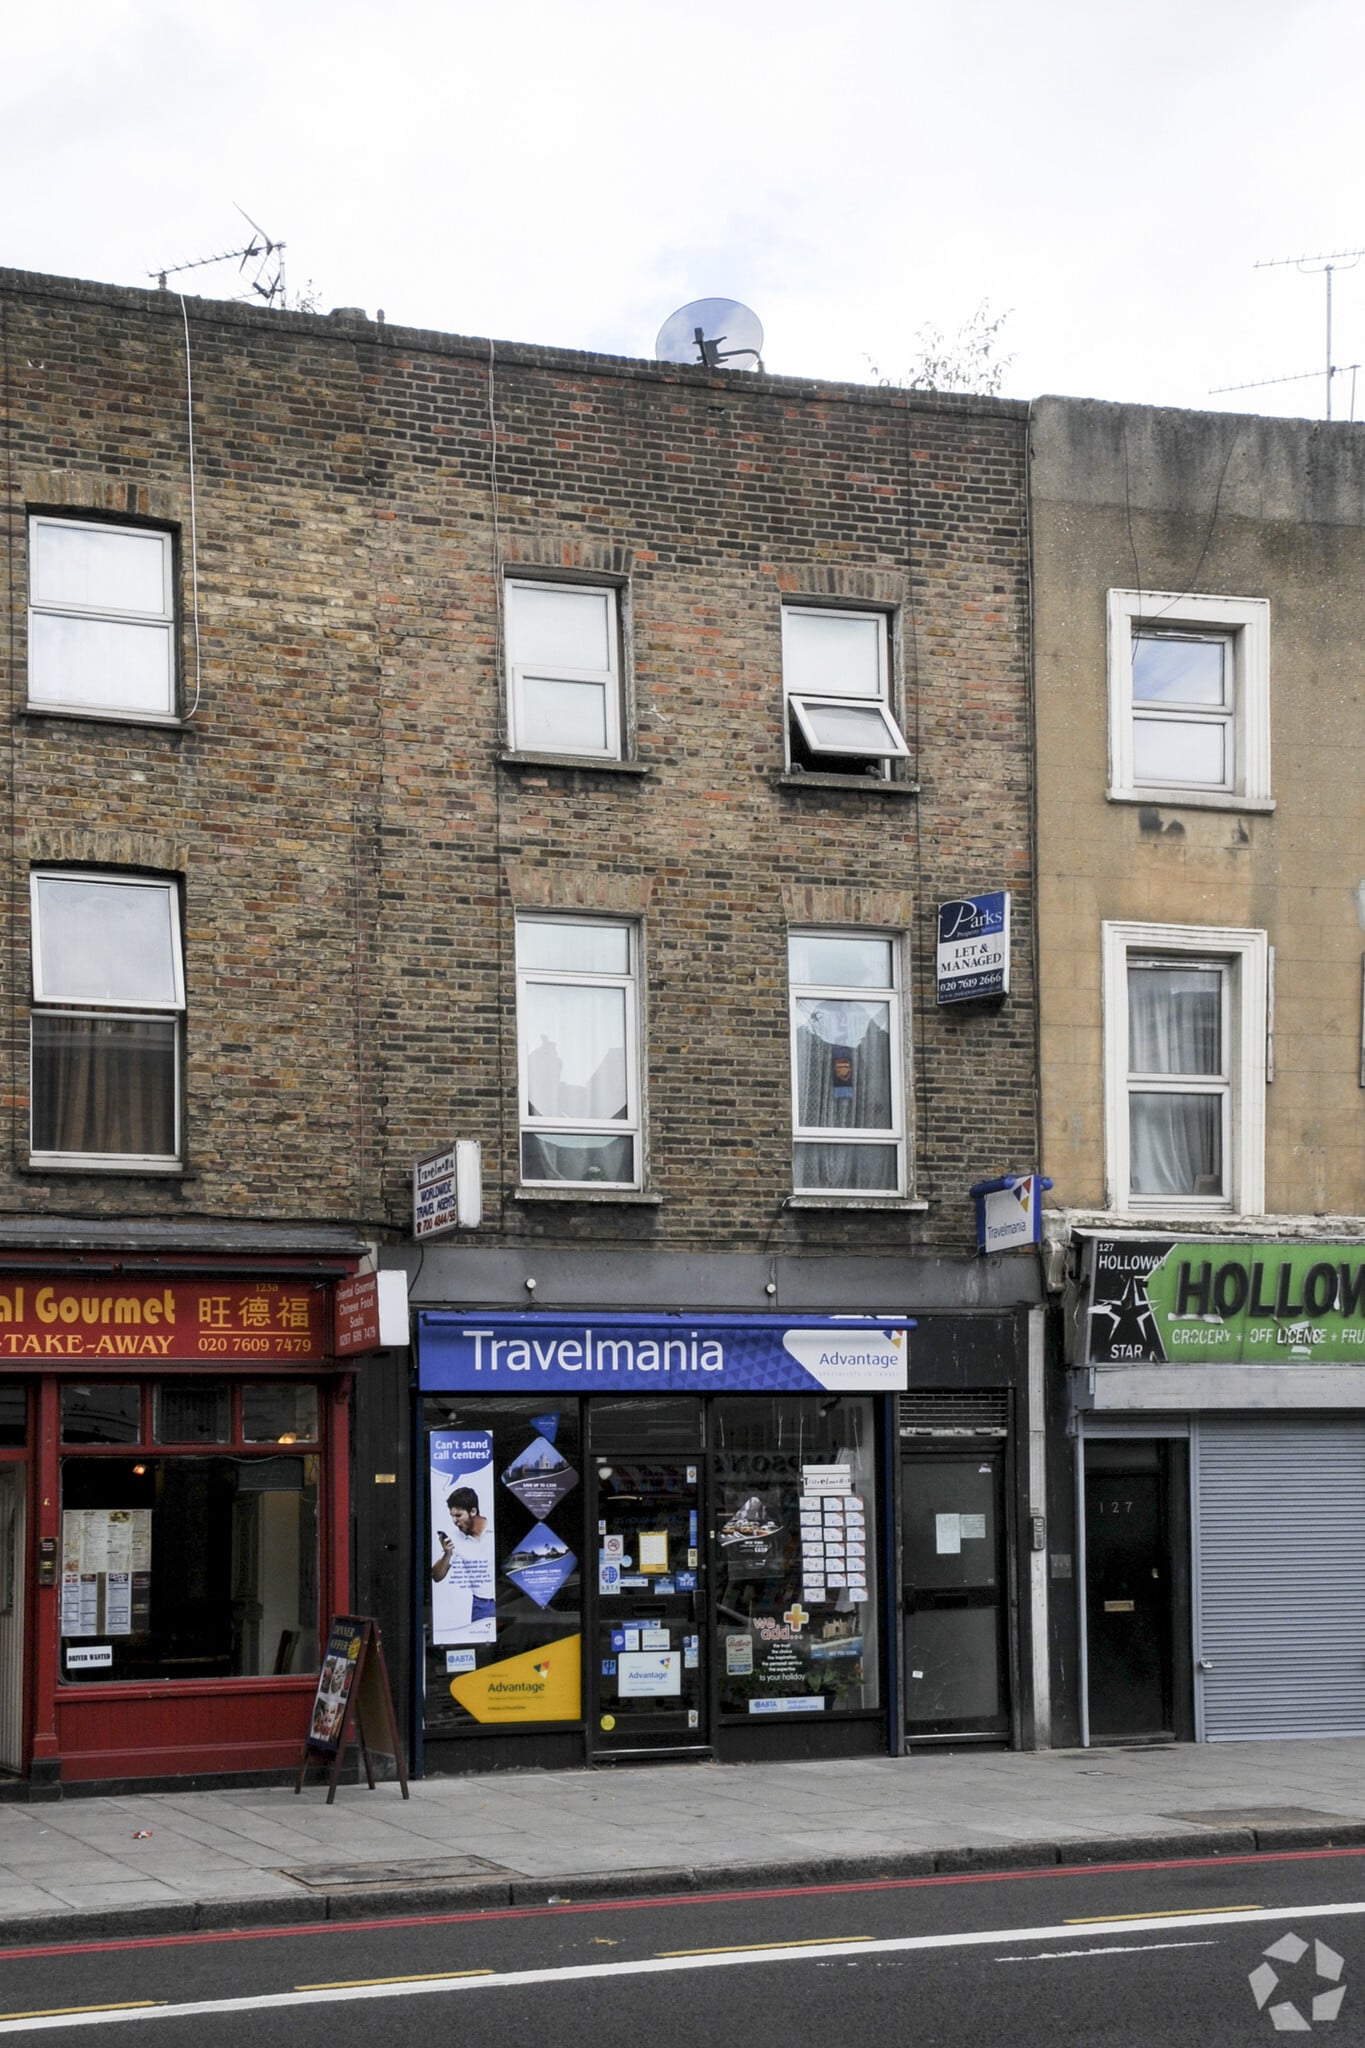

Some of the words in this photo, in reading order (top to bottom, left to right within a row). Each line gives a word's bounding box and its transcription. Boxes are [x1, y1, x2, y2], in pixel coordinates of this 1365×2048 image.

[939, 900, 1002, 938] Parks
[955, 946, 977, 959] LET
[979, 943, 989, 954] &
[940, 952, 1003, 974] MANAGED
[940, 982, 957, 992] 020
[957, 977, 978, 990] 7619
[980, 972, 1002, 986] 2666
[421, 1179, 452, 1203] WORLDWIDE
[416, 1202, 435, 1220] TRAVEL
[437, 1193, 456, 1213] AGENTS
[423, 1217, 433, 1232] 700
[987, 1220, 1026, 1239] Travelmania
[1099, 1243, 1115, 1252] 127
[256, 1283, 279, 1292] 123a
[35, 1286, 175, 1325] Gourmet
[360, 1295, 374, 1309] Food
[199, 1296, 310, 1328] 旺德福
[349, 1313, 364, 1328] Sushi
[1172, 1329, 1231, 1344] GROCERY
[1250, 1329, 1274, 1343] OFF
[1277, 1329, 1327, 1344] LICENCE
[199, 1338, 227, 1352] 020
[232, 1338, 270, 1352] 7609
[275, 1338, 312, 1352] 7479
[463, 1330, 724, 1371] Travelmania
[1110, 1344, 1143, 1359] STAR
[819, 1352, 898, 1368] Advantage
[435, 1440, 459, 1449] Can't
[462, 1440, 488, 1449] stand
[433, 1450, 449, 1459] call
[452, 1450, 491, 1459] centres?
[1100, 1502, 1132, 1513] 127
[753, 1617, 775, 1629] we
[68, 1654, 88, 1662] DRIVER
[89, 1653, 111, 1661] WANTED
[628, 1672, 668, 1680] Advantage
[767, 1674, 781, 1682] your
[782, 1672, 806, 1681] holiday
[488, 1682, 545, 1693] Advantage
